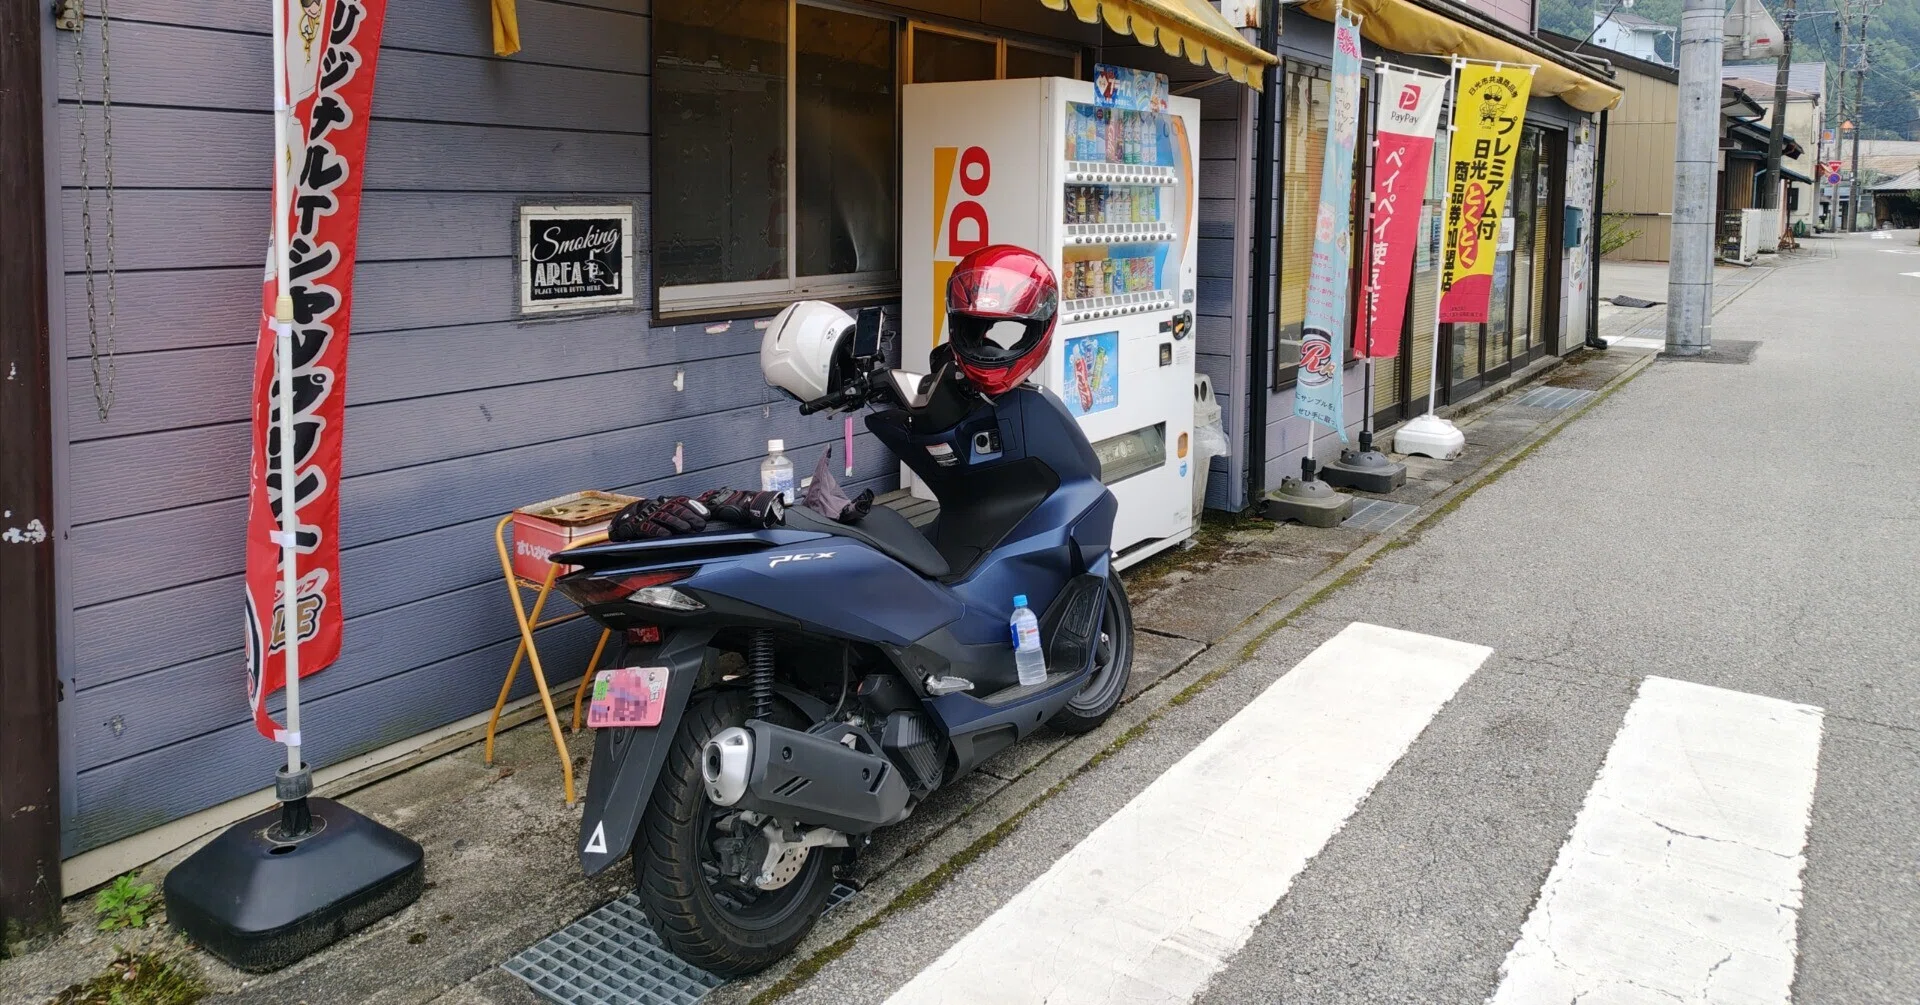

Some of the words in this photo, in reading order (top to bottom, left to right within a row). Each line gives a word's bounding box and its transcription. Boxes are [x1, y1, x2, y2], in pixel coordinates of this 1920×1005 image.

[1468, 75, 1519, 98] 日光市共通商品券
[1391, 110, 1419, 125] PayPay
[1477, 115, 1518, 241] プレミアム付
[1441, 160, 1470, 292] 商品券加盟店
[532, 225, 621, 262] Smoking
[267, 0, 360, 564] リジナルTシャツプリン
[534, 262, 583, 287] AREA
[534, 287, 553, 295] PLACE
[554, 286, 568, 294] YOUR
[569, 285, 585, 293] BUTTS
[586, 284, 601, 292] HERE
[1295, 392, 1336, 412] にサンプルを
[1298, 408, 1338, 427] ぜひ手に取っ
[768, 551, 837, 569] PCX
